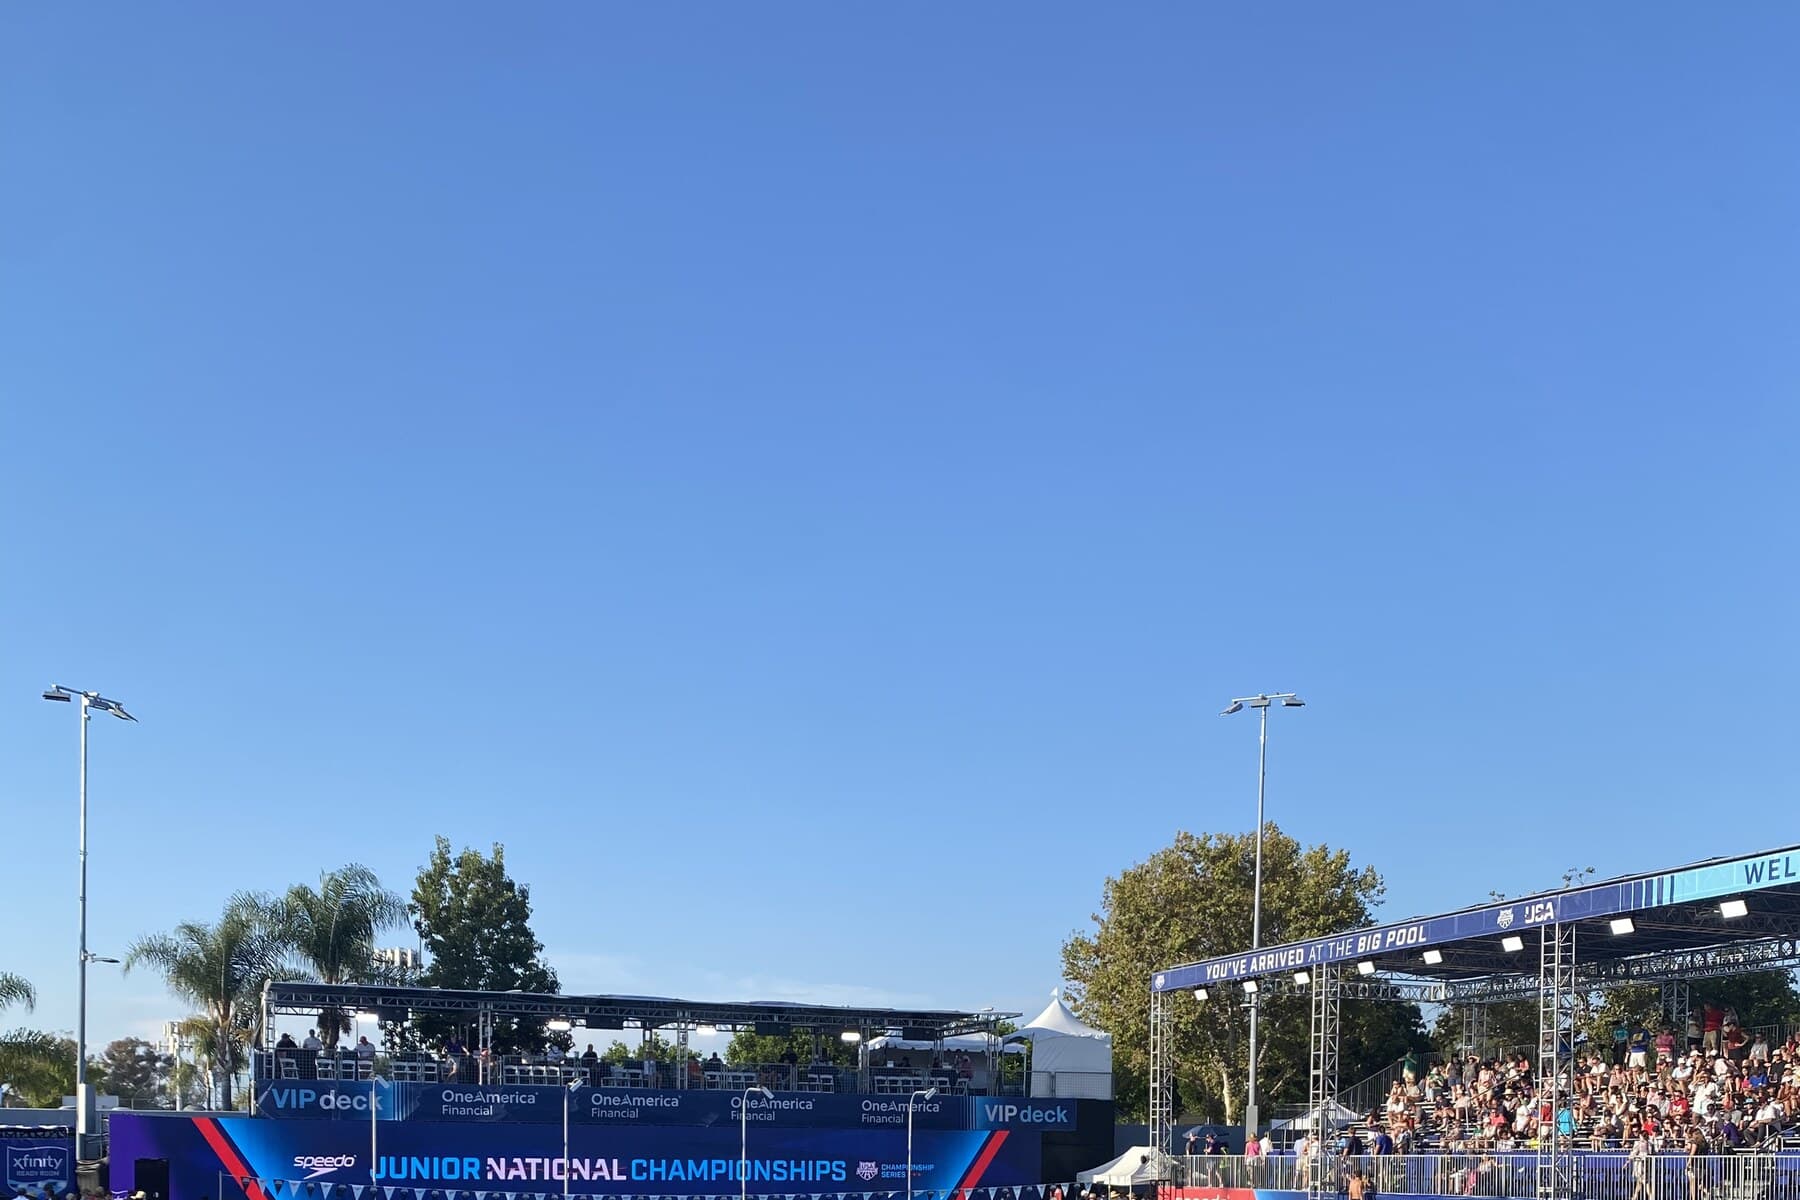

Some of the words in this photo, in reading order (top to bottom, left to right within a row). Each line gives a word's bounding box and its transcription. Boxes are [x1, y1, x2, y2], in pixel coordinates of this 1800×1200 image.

[1744, 856, 1797, 885] WEL
[1524, 901, 1555, 924] USA
[1206, 958, 1247, 981] YOU'VE
[1250, 948, 1304, 973] ARRIVED
[1308, 944, 1322, 962] AT
[1326, 938, 1353, 959] THE
[1357, 933, 1382, 953] BIG
[1386, 926, 1427, 947] POOL
[272, 1088, 316, 1109] VIP
[319, 1089, 384, 1111] deck
[441, 1089, 537, 1105] OneAmerica
[591, 1093, 680, 1107] OneAmerica
[730, 1096, 814, 1110] OneAmerica
[442, 1105, 493, 1117] Financial
[591, 1107, 639, 1119] Financial
[861, 1099, 940, 1113] OneAmerica
[984, 1104, 1018, 1122] VIP
[1020, 1105, 1068, 1123] deck
[730, 1110, 776, 1121] Financial
[861, 1113, 904, 1124] Financial
[13, 1154, 63, 1170] xfinity
[294, 1154, 355, 1169] speedo
[370, 1156, 481, 1180] JUNIOR
[486, 1157, 627, 1181] NATIONAL
[631, 1158, 846, 1182] CHAMPIONSHIPS
[881, 1171, 906, 1179] SERIES
